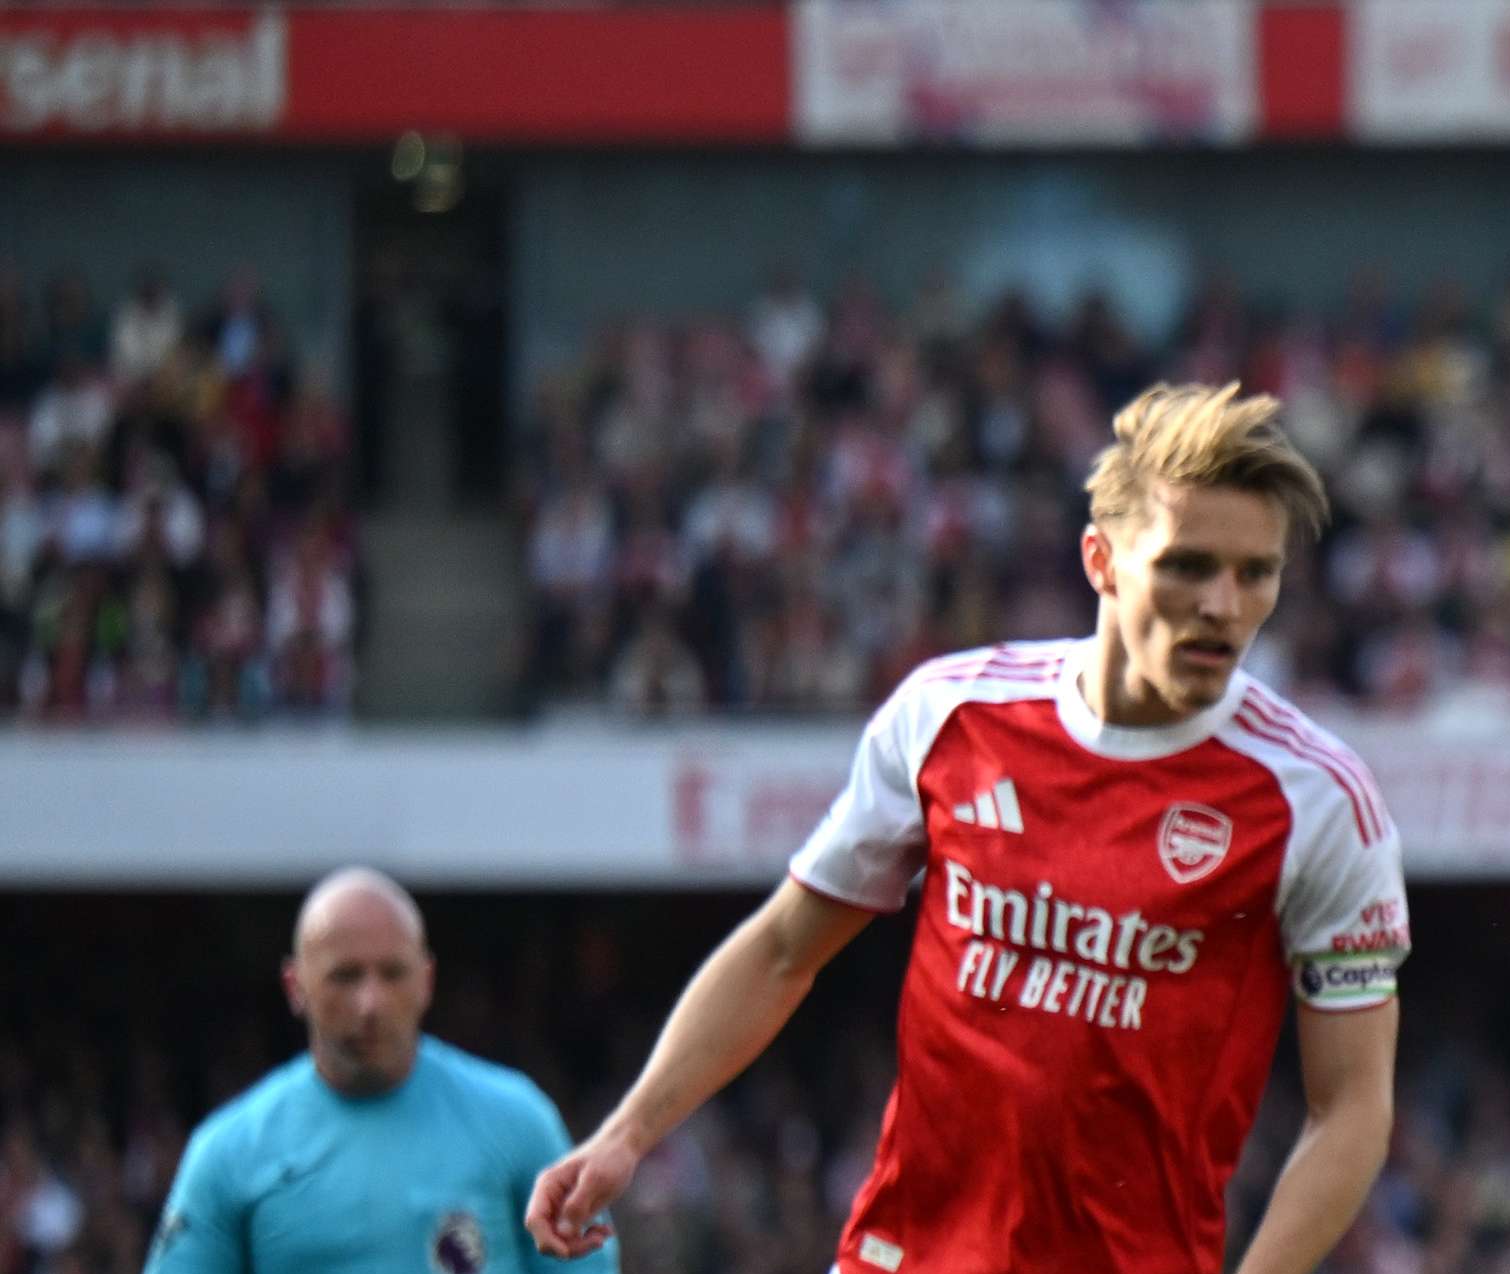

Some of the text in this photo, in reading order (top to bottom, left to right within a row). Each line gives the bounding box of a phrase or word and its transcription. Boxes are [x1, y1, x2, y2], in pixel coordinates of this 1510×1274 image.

[0, 10, 288, 130] senal
[945, 859, 1204, 975] Emirates
[957, 939, 1148, 1030] FLY BETTER
[1326, 963, 1394, 990] Capta
